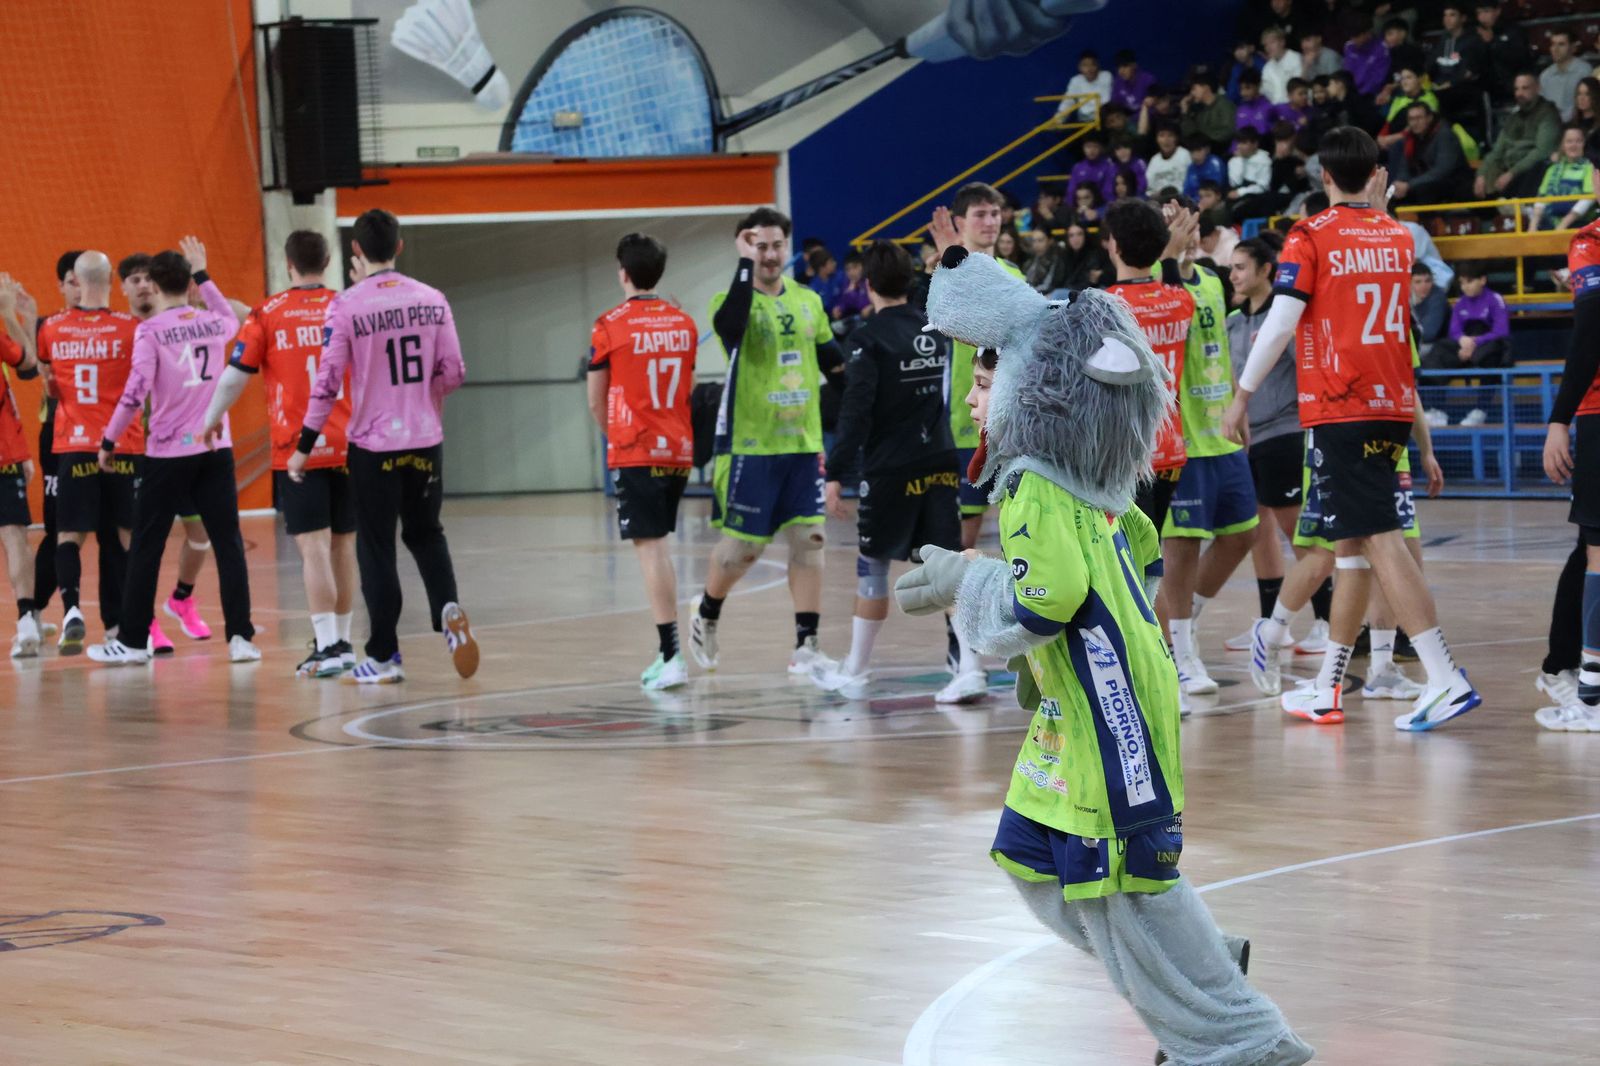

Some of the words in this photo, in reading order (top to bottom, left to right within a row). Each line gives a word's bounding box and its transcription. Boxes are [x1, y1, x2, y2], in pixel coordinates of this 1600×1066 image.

[1328, 248, 1403, 276] SAMUEL
[352, 307, 405, 338] ÁLVARO
[408, 301, 446, 327] PÉREZ
[1356, 283, 1406, 345] 24
[51, 337, 107, 360] ADRIÁN
[275, 329, 293, 350] R.
[296, 326, 324, 347] RO
[630, 329, 690, 354] ZAPICO
[1303, 323, 1313, 369] Finura
[177, 341, 212, 387] 12
[385, 335, 424, 386] 16
[74, 364, 98, 404] 9
[646, 357, 682, 410] 17
[1394, 491, 1415, 516] 25
[1021, 586, 1047, 597] EJO
[1101, 696, 1111, 716] Alta
[1122, 687, 1141, 733] Montajes
[1105, 679, 1139, 760] PIORNO,
[1133, 763, 1144, 797] S.L.
